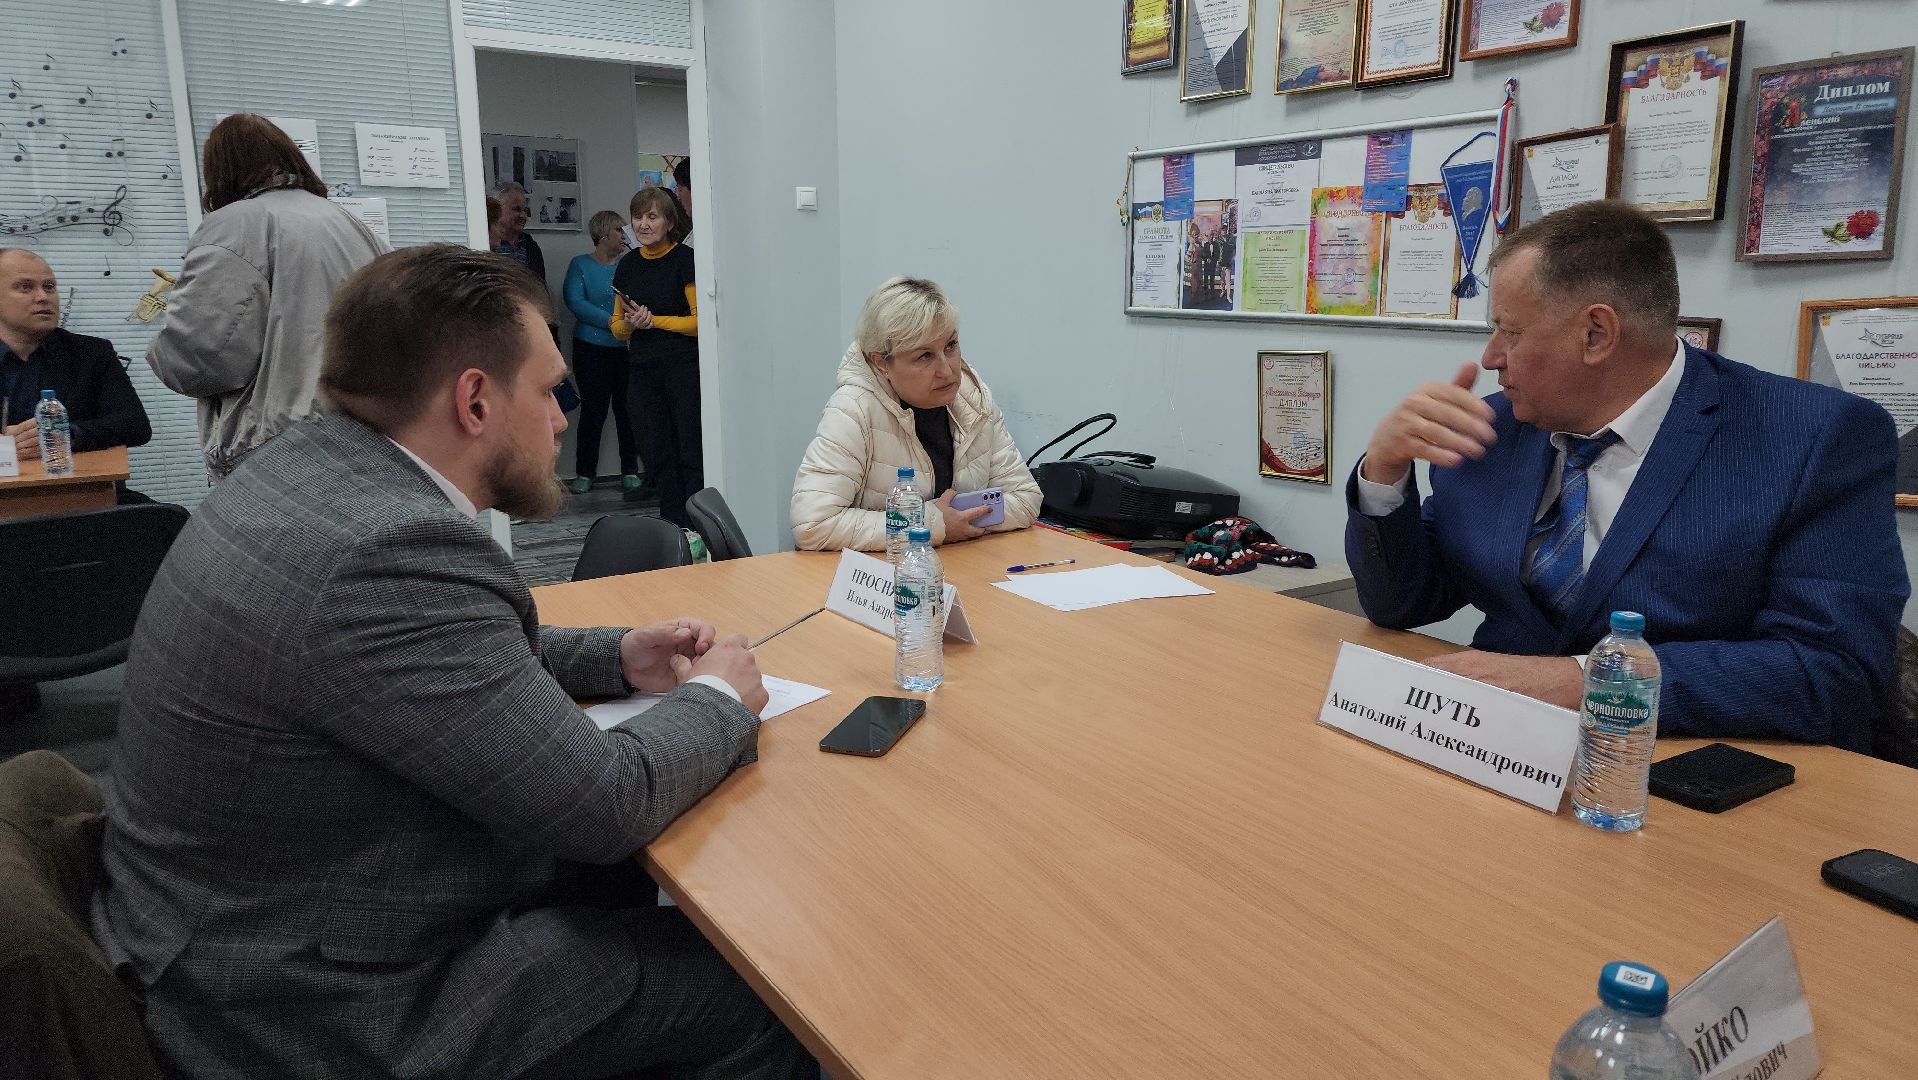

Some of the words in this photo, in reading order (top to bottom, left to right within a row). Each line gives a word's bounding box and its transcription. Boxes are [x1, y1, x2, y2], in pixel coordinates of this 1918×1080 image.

[1641, 88, 1707, 104] БЛАГОДАРНОСТЬ
[1814, 81, 1891, 104] Диплом
[846, 589, 868, 608] Илья
[1404, 686, 1481, 728] ШУТЬ
[1329, 692, 1407, 732] Анатолий
[1410, 721, 1562, 789] Александрович
